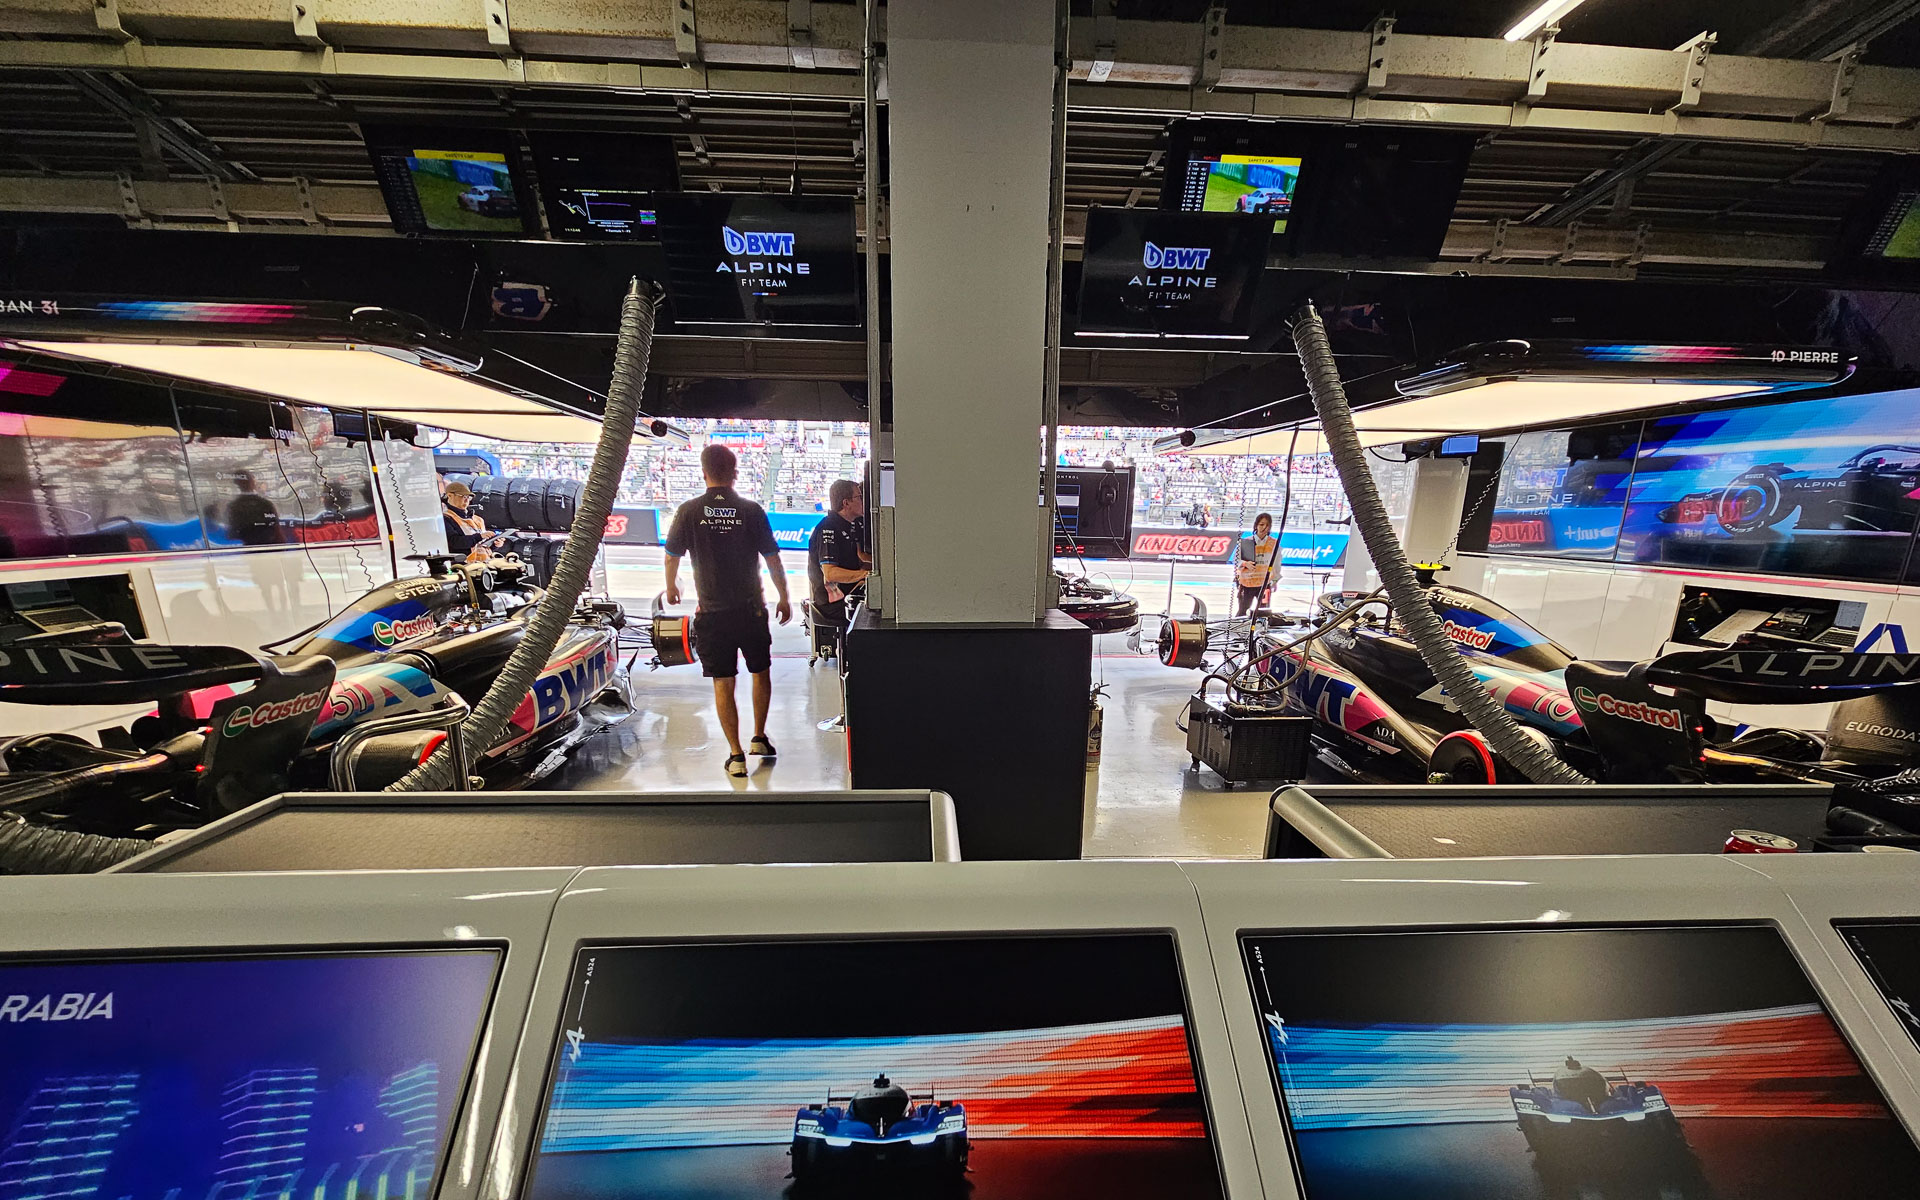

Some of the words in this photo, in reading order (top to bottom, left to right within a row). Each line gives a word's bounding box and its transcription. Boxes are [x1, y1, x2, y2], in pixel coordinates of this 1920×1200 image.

[744, 232, 795, 256] BWT
[716, 261, 810, 274] ALPINE
[1162, 247, 1211, 270] BWT
[759, 279, 787, 287] TEAM
[1128, 275, 1217, 288] ALPINE
[1166, 292, 1191, 300] TEAM
[41, 300, 59, 315] 31
[1771, 350, 1786, 363] 10
[1790, 351, 1839, 363] PIERRE
[1794, 480, 1847, 489] ALPINE
[1502, 494, 1574, 504] ALPINE
[714, 508, 736, 517] BWT
[1136, 535, 1231, 555] KNUCKLES
[394, 583, 443, 600] E-TECH
[1426, 592, 1474, 610] E-TECH
[391, 612, 437, 641] Castrol
[1443, 620, 1496, 650] Castrol
[533, 650, 609, 729] BWT
[250, 686, 330, 729] Castrol
[1597, 693, 1683, 732] Castrol
[1374, 726, 1396, 740] ADA
[1845, 720, 1920, 743] EURODA
[586, 956, 596, 977] A524
[0, 992, 115, 1023] RABIA
